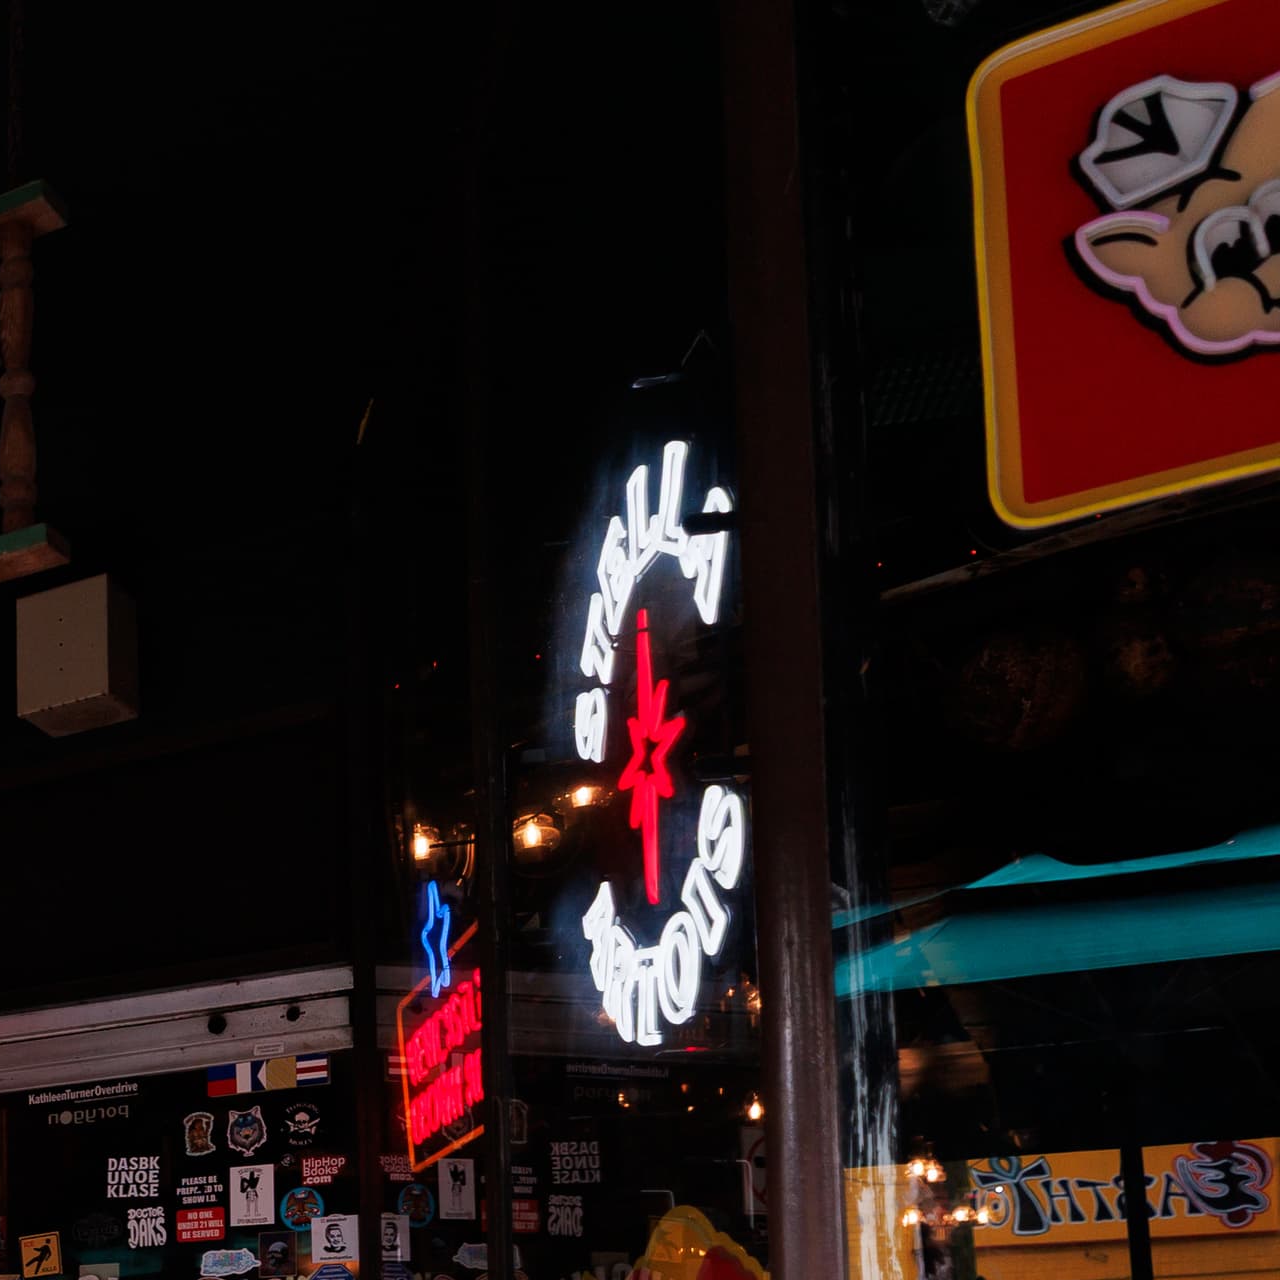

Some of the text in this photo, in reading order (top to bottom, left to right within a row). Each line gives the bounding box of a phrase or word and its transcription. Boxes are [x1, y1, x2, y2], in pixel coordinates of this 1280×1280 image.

[28, 1081, 139, 1105] KathleenTurnerOverdrive
[107, 1157, 160, 1172] DASBK
[303, 1156, 345, 1170] HipHop
[107, 1170, 160, 1185] UNOE
[303, 1166, 338, 1176] Books
[303, 1175, 332, 1185] .com
[107, 1184, 160, 1199] KLASE
